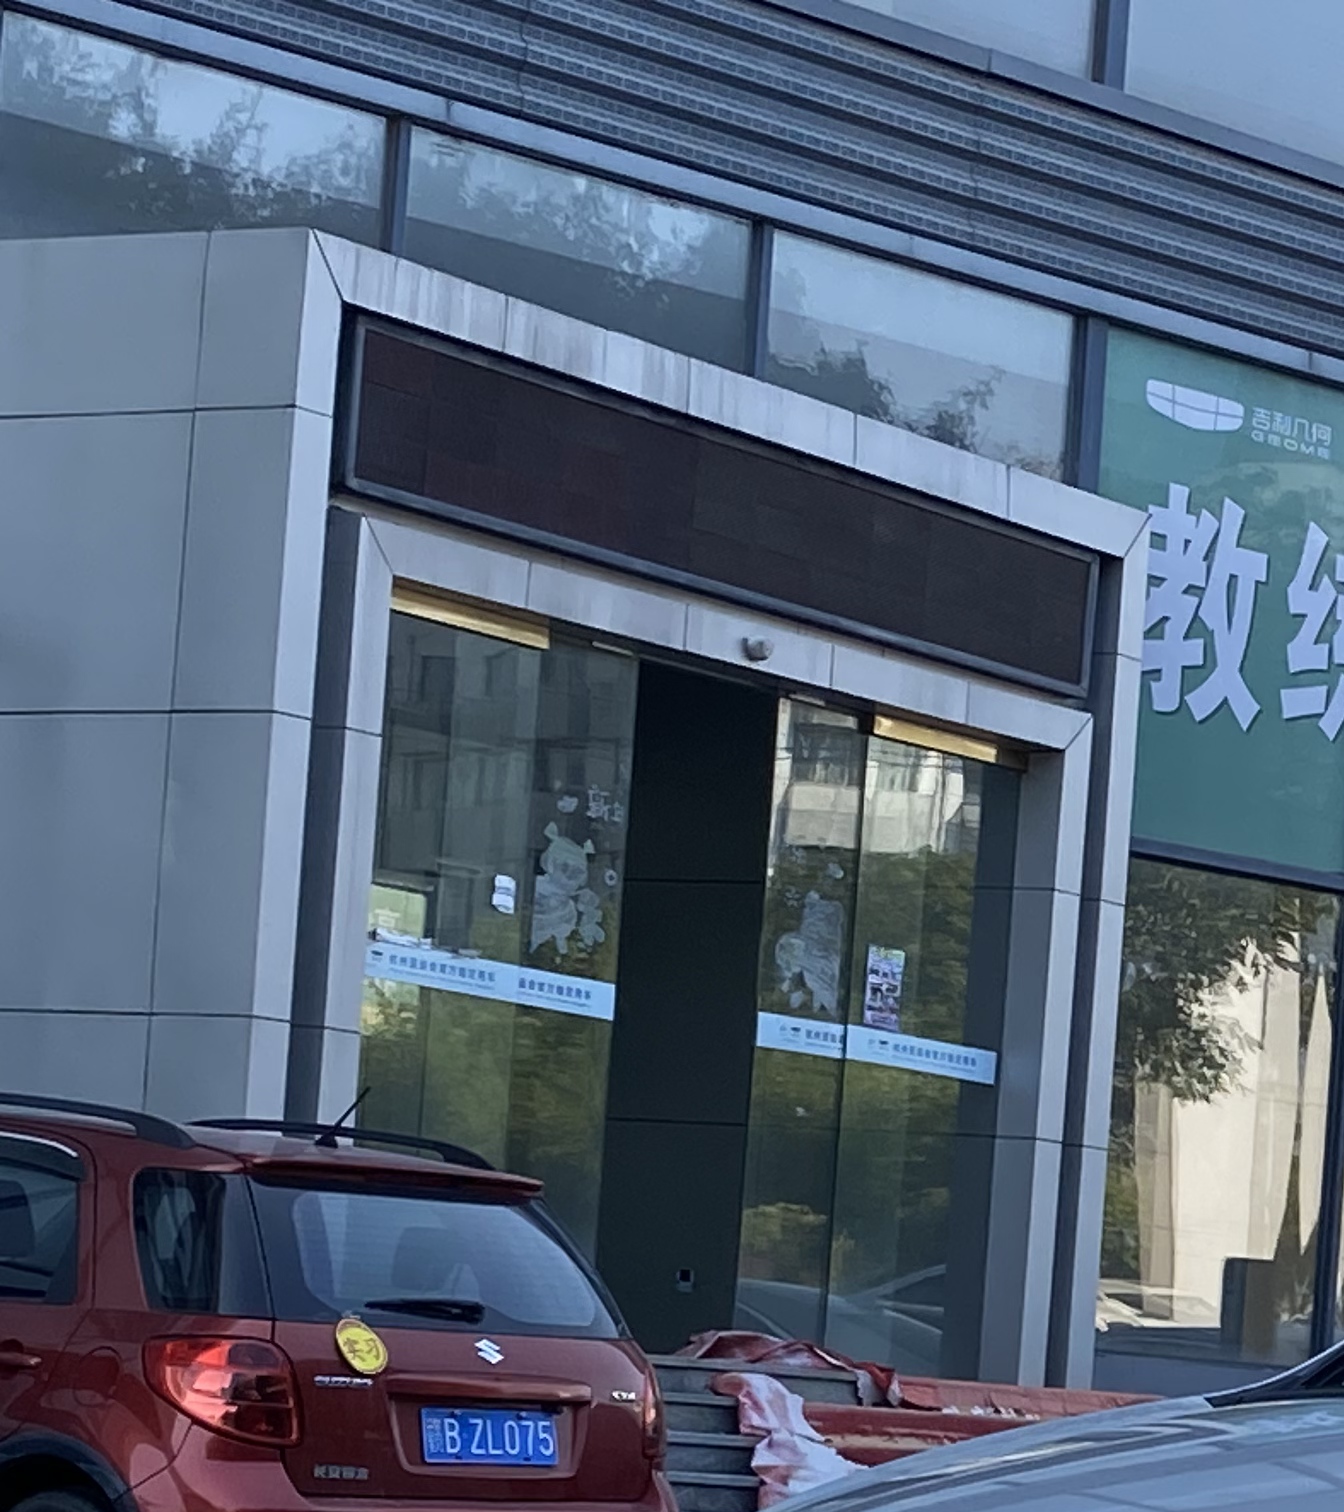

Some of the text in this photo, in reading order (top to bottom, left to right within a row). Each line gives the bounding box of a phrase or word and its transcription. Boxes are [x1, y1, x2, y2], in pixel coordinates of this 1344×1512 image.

[1252, 407, 1332, 446] 吉利几何
[342, 1336, 381, 1363] 实习
